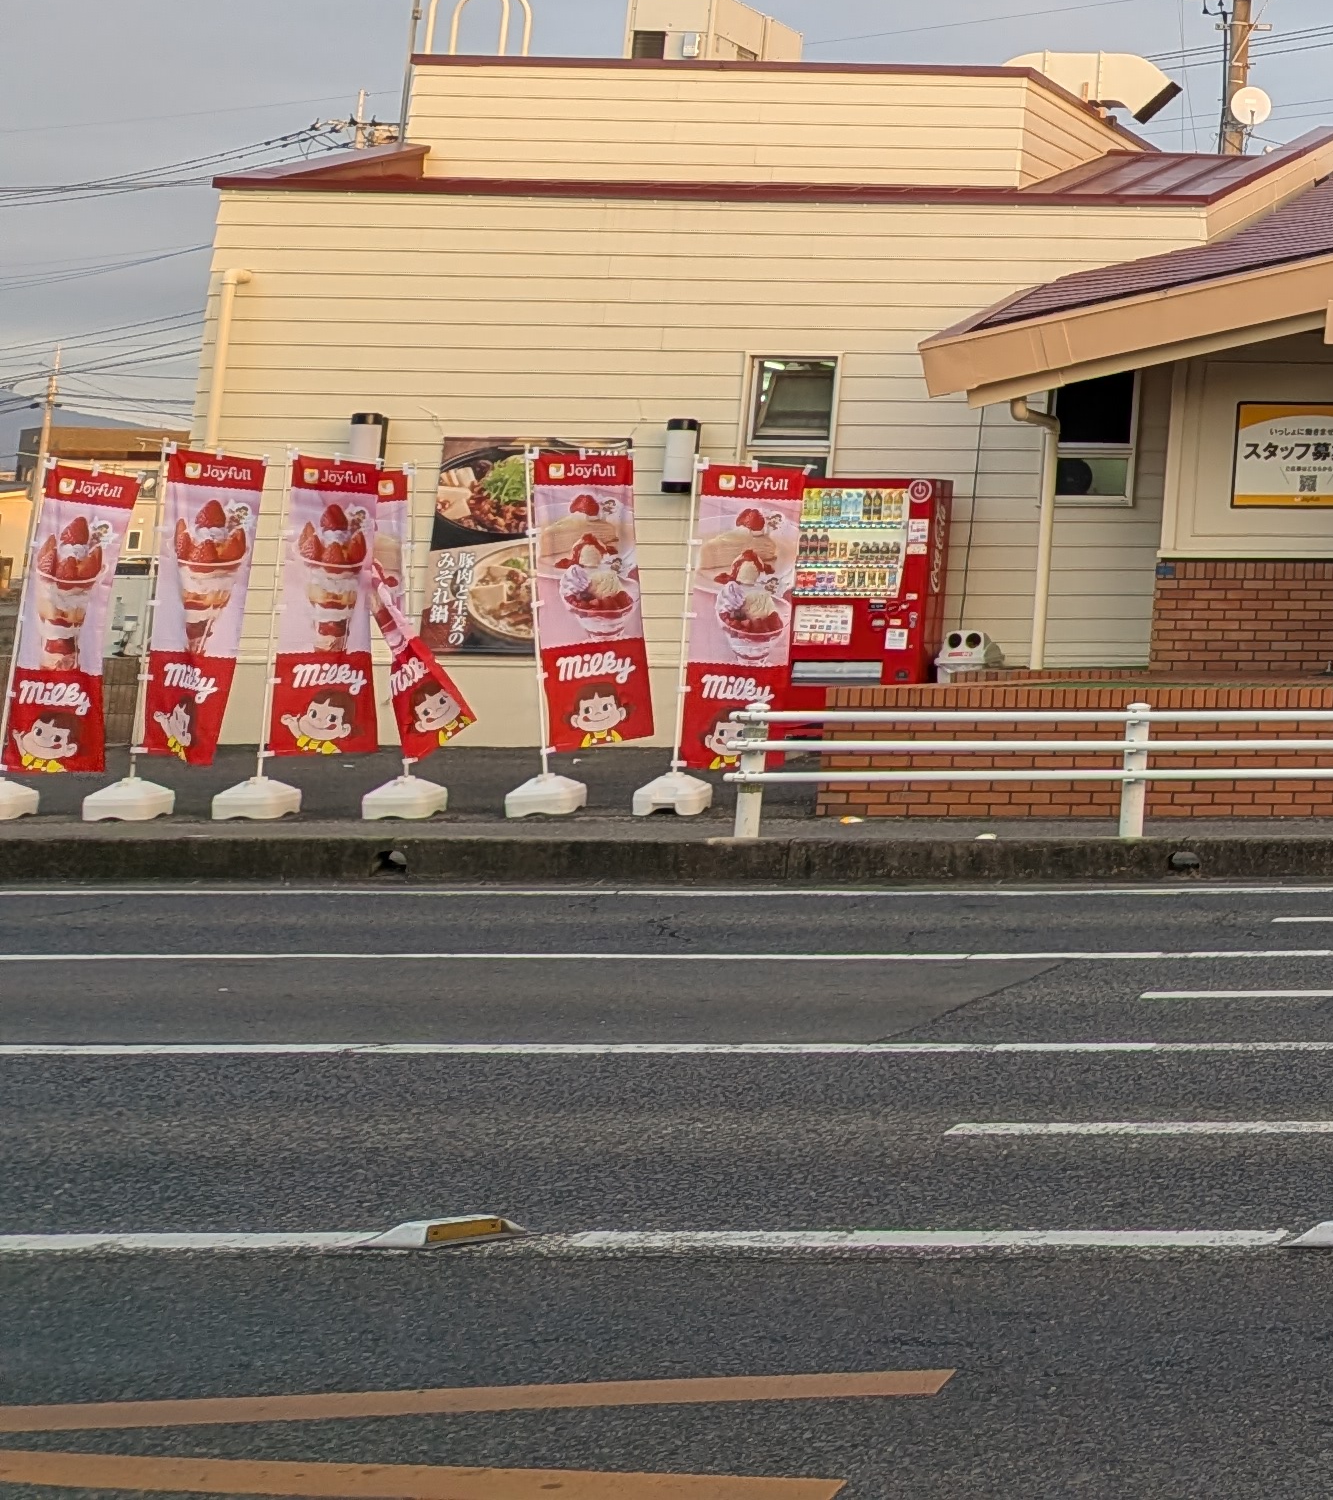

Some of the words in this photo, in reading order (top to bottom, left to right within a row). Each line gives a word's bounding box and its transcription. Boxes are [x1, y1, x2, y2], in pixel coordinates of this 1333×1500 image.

[203, 463, 252, 482] Joyfull
[321, 469, 367, 485] Joyfull
[567, 463, 616, 479] Joyfull
[75, 481, 123, 498] Joyfull
[738, 475, 789, 493] Joyfull
[430, 553, 454, 623] みぞれ鍋
[292, 663, 367, 695] Milky
[390, 657, 429, 696] Milk
[556, 651, 636, 684] Milky
[19, 680, 91, 715] Milky
